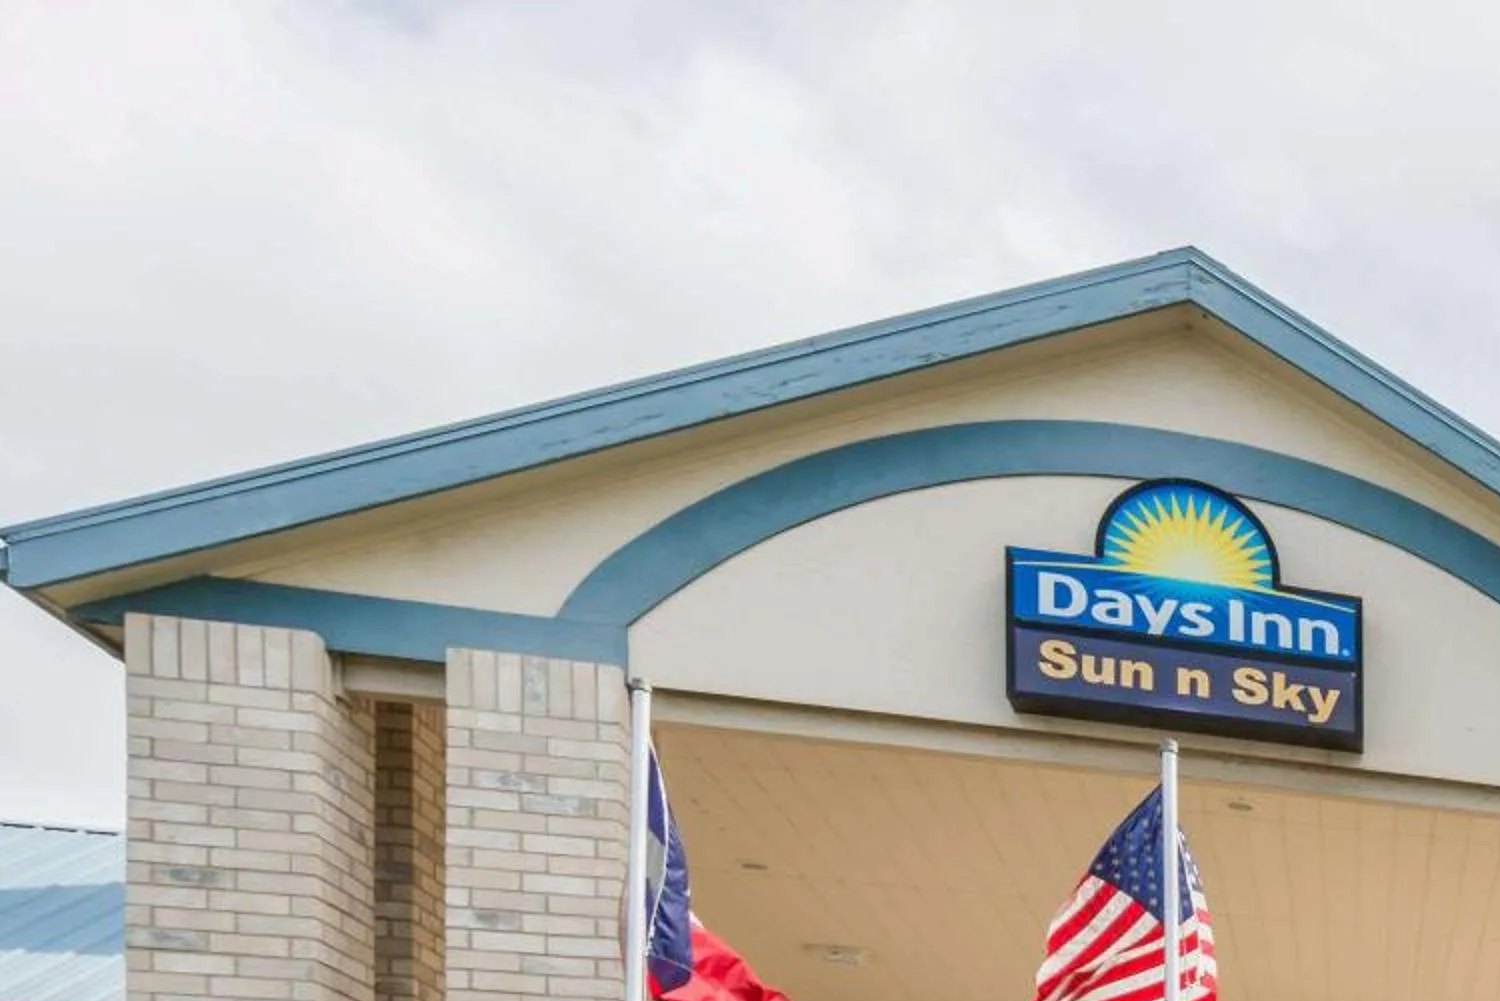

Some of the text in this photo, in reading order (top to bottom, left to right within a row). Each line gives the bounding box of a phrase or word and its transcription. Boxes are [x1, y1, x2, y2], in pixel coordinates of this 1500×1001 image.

[1037, 571, 1215, 637] Days
[1038, 639, 1340, 724] Sun n Sky
